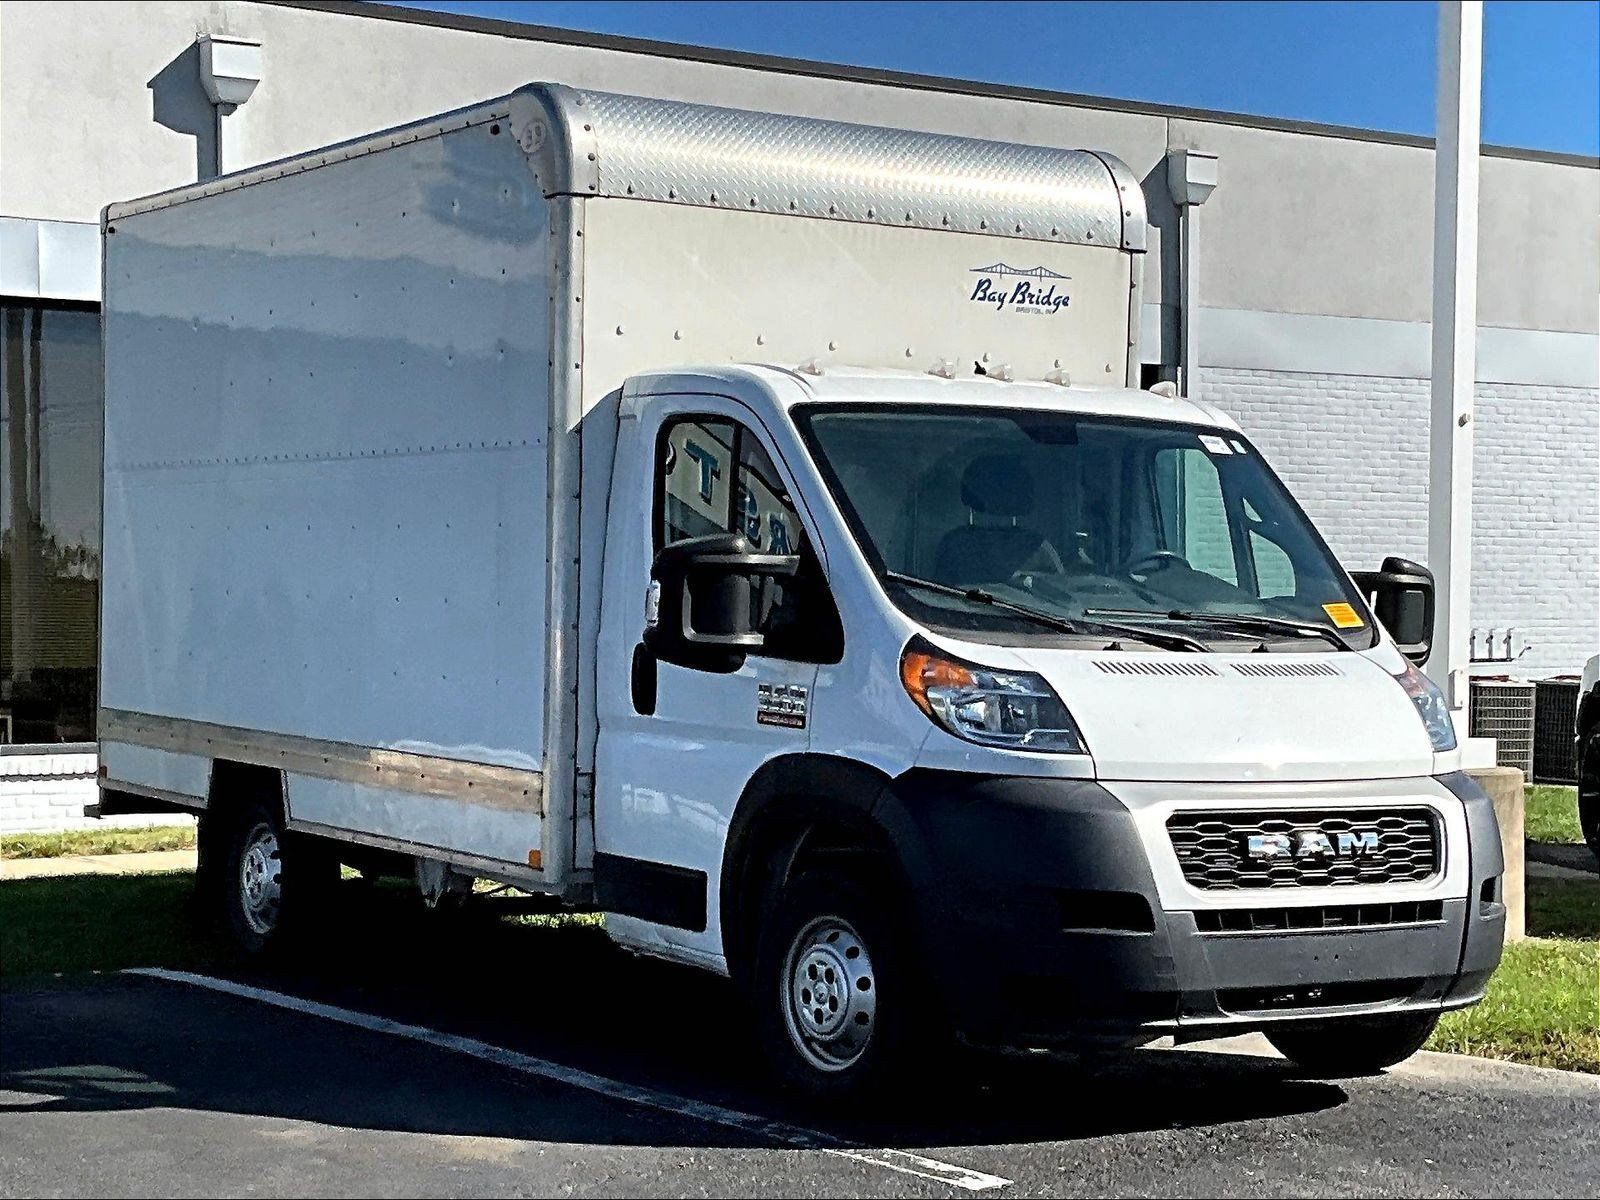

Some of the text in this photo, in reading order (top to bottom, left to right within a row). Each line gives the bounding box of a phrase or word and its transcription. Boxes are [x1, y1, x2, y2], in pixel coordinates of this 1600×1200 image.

[970, 278, 1070, 314] Bay Bridge
[1248, 832, 1379, 857] RAM
